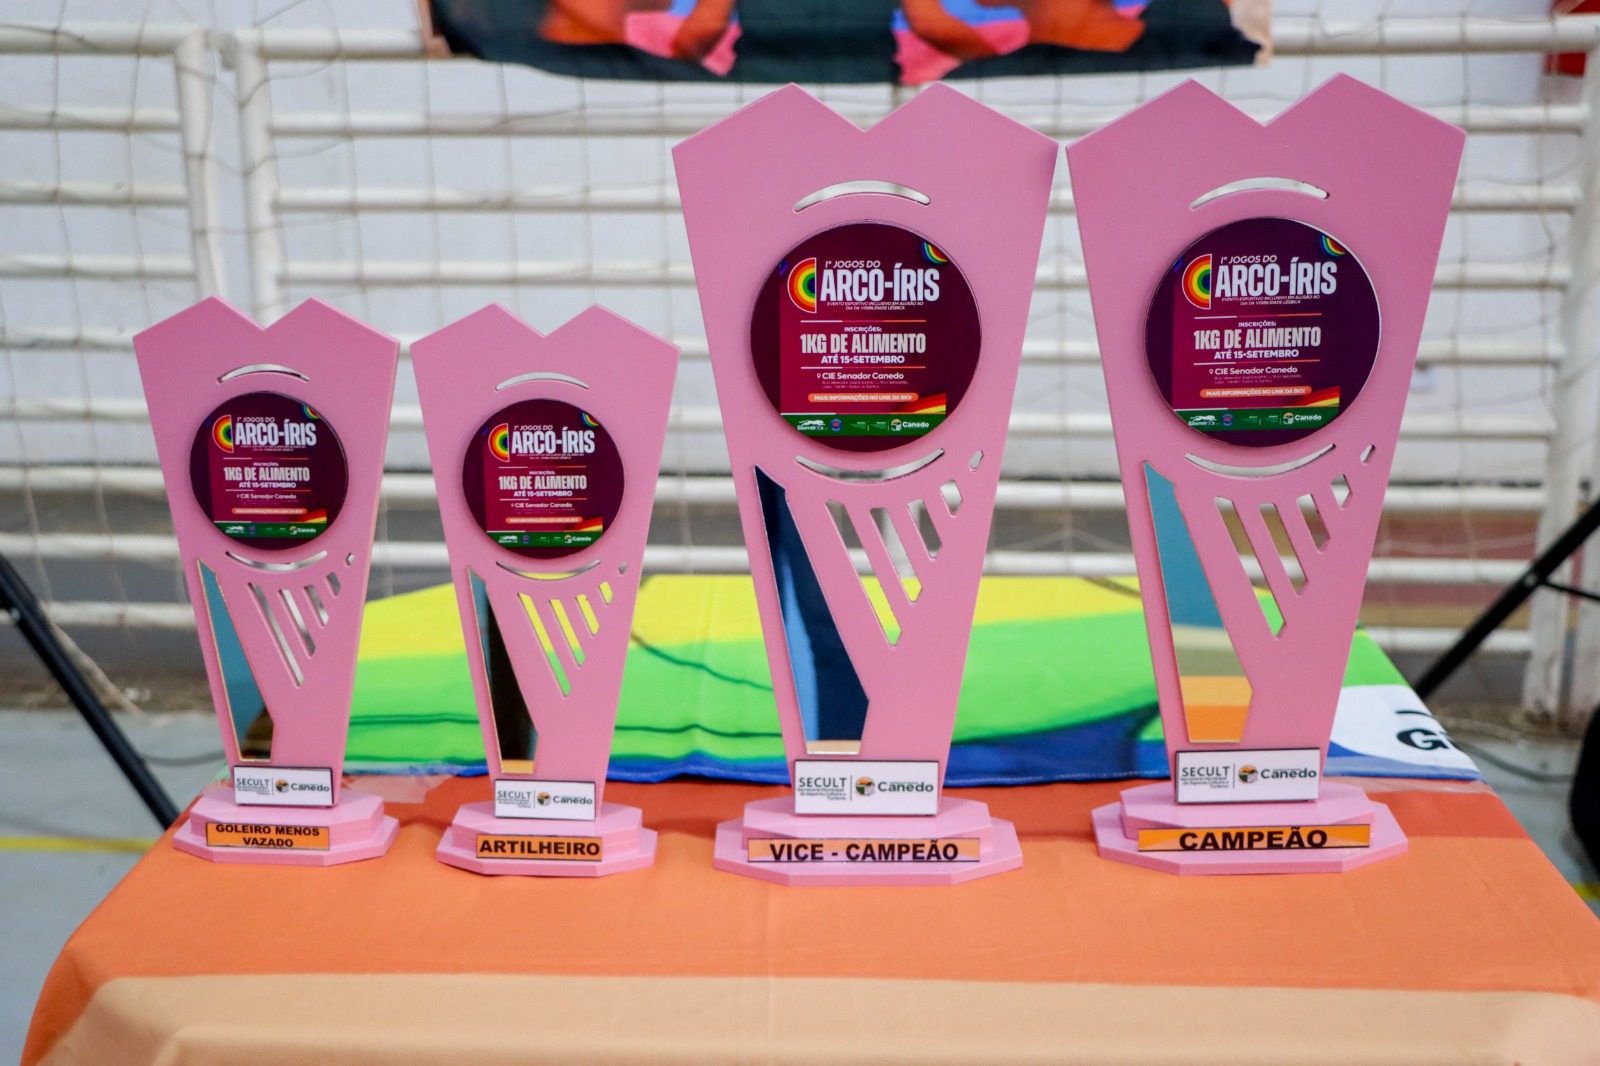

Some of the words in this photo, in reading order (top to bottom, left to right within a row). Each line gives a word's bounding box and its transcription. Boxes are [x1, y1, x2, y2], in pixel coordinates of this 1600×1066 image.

[833, 260, 865, 268] JOGOS
[866, 260, 881, 268] DO
[1229, 256, 1261, 264] JOGOS
[1263, 255, 1277, 263] DO
[820, 263, 940, 302] ARCO-ÍRIS
[1215, 257, 1337, 298] ARCO-ÍRIS
[800, 334, 826, 353] 1KG
[830, 334, 848, 353] DE
[852, 333, 926, 353] ALIMENTO
[1194, 330, 1220, 350] 1KG
[1224, 329, 1242, 348] DE
[1245, 326, 1322, 348] ALIMENTO
[821, 354, 838, 364] ATÉ
[1214, 350, 1232, 360] ATÉ
[235, 419, 317, 446] ARCO-ÍRIS
[512, 426, 596, 454] ARCO-ÍRIS
[224, 467, 242, 481] 1KG
[244, 467, 256, 481] DE
[259, 467, 310, 481] ALIMENTO
[498, 476, 518, 490] 1KG
[520, 476, 532, 490] DE
[535, 475, 587, 490] ALIMENTO
[1182, 766, 1230, 776] SECULT
[1260, 768, 1317, 779] Canedo
[236, 778, 270, 786] SECULT
[291, 783, 330, 792] Canedo
[799, 777, 847, 787] SECULT
[878, 781, 934, 792] Canedo
[553, 796, 592, 804] Canedo
[216, 824, 271, 834] GOLEIRO
[276, 826, 320, 836] MENOS
[243, 837, 293, 847] VAZADO
[1179, 827, 1328, 850] CAMPEÃO
[480, 840, 600, 855] ARTILHEIRO
[770, 843, 824, 861] VICE
[846, 839, 958, 861] CAMPEÃO
